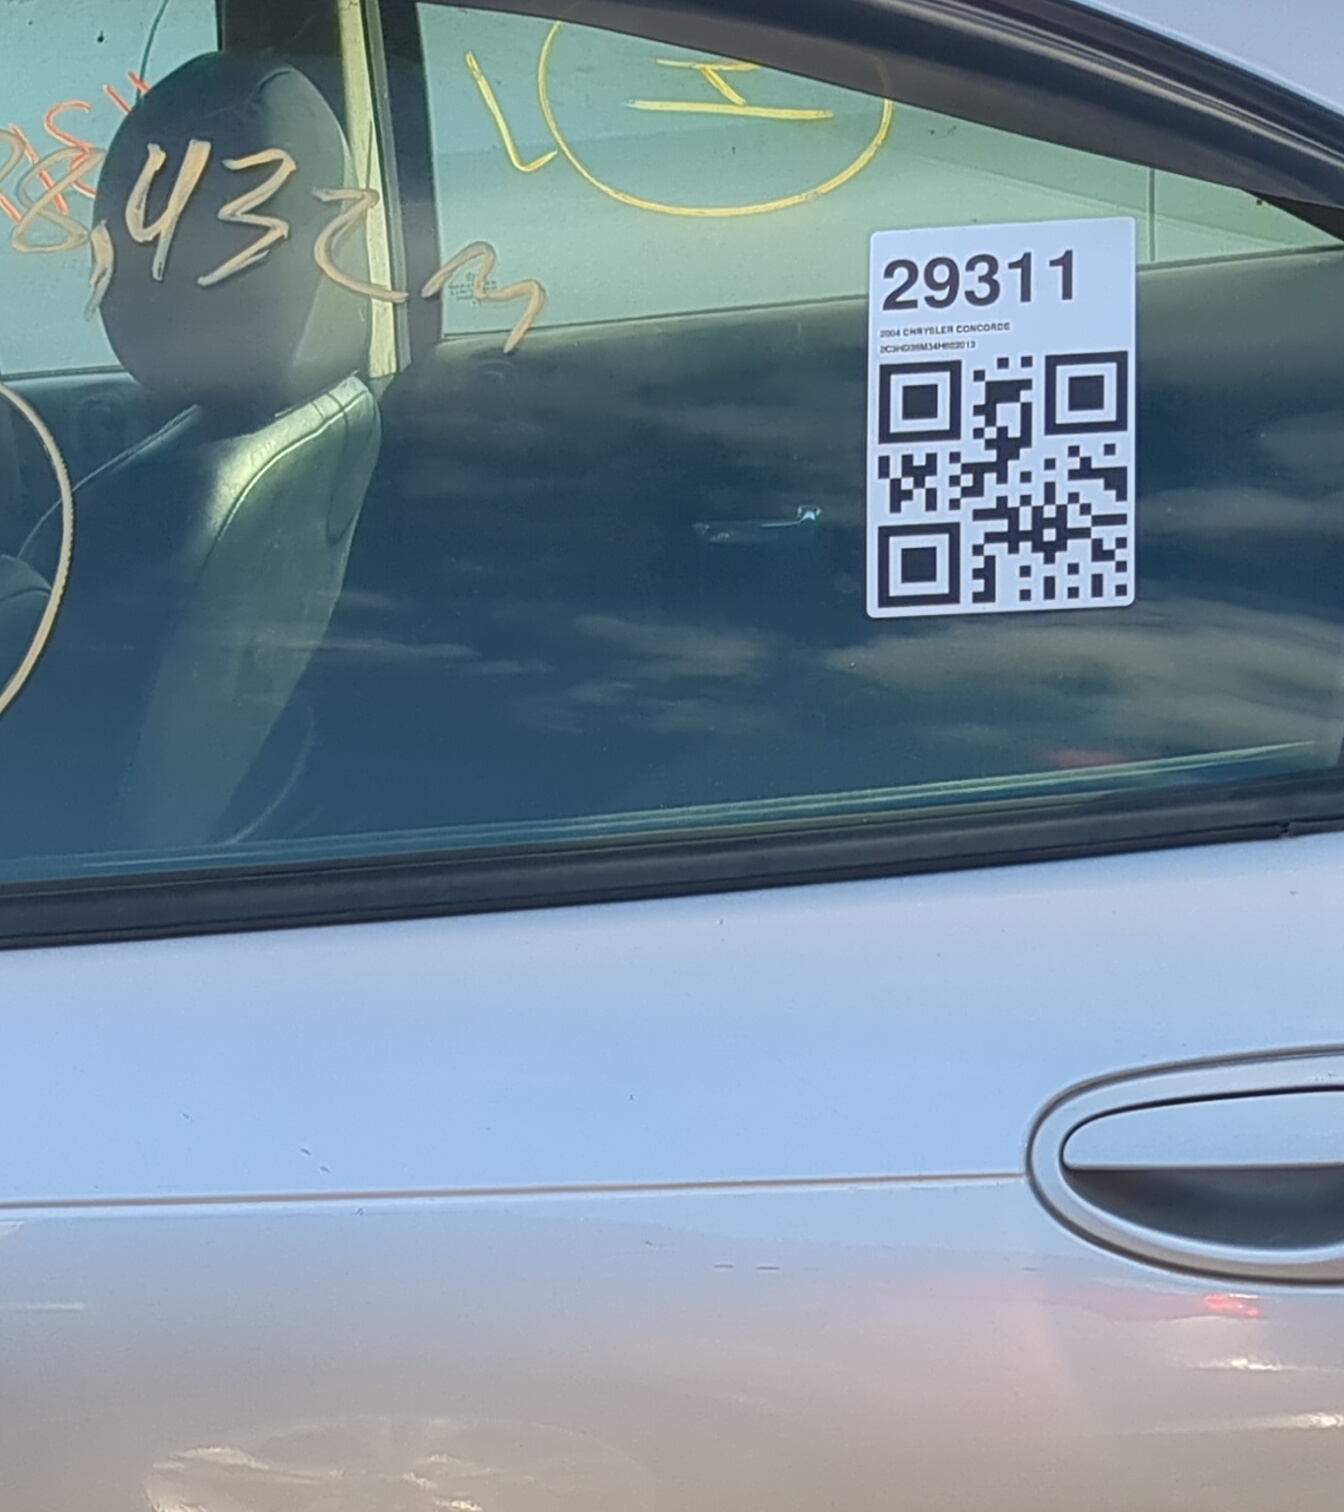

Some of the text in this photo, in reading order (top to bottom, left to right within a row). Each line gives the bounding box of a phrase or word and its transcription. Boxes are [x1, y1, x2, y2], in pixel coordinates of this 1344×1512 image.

[882, 249, 1075, 312] 29311
[879, 321, 1011, 338] 2004 CHRYSLER CONCORDE
